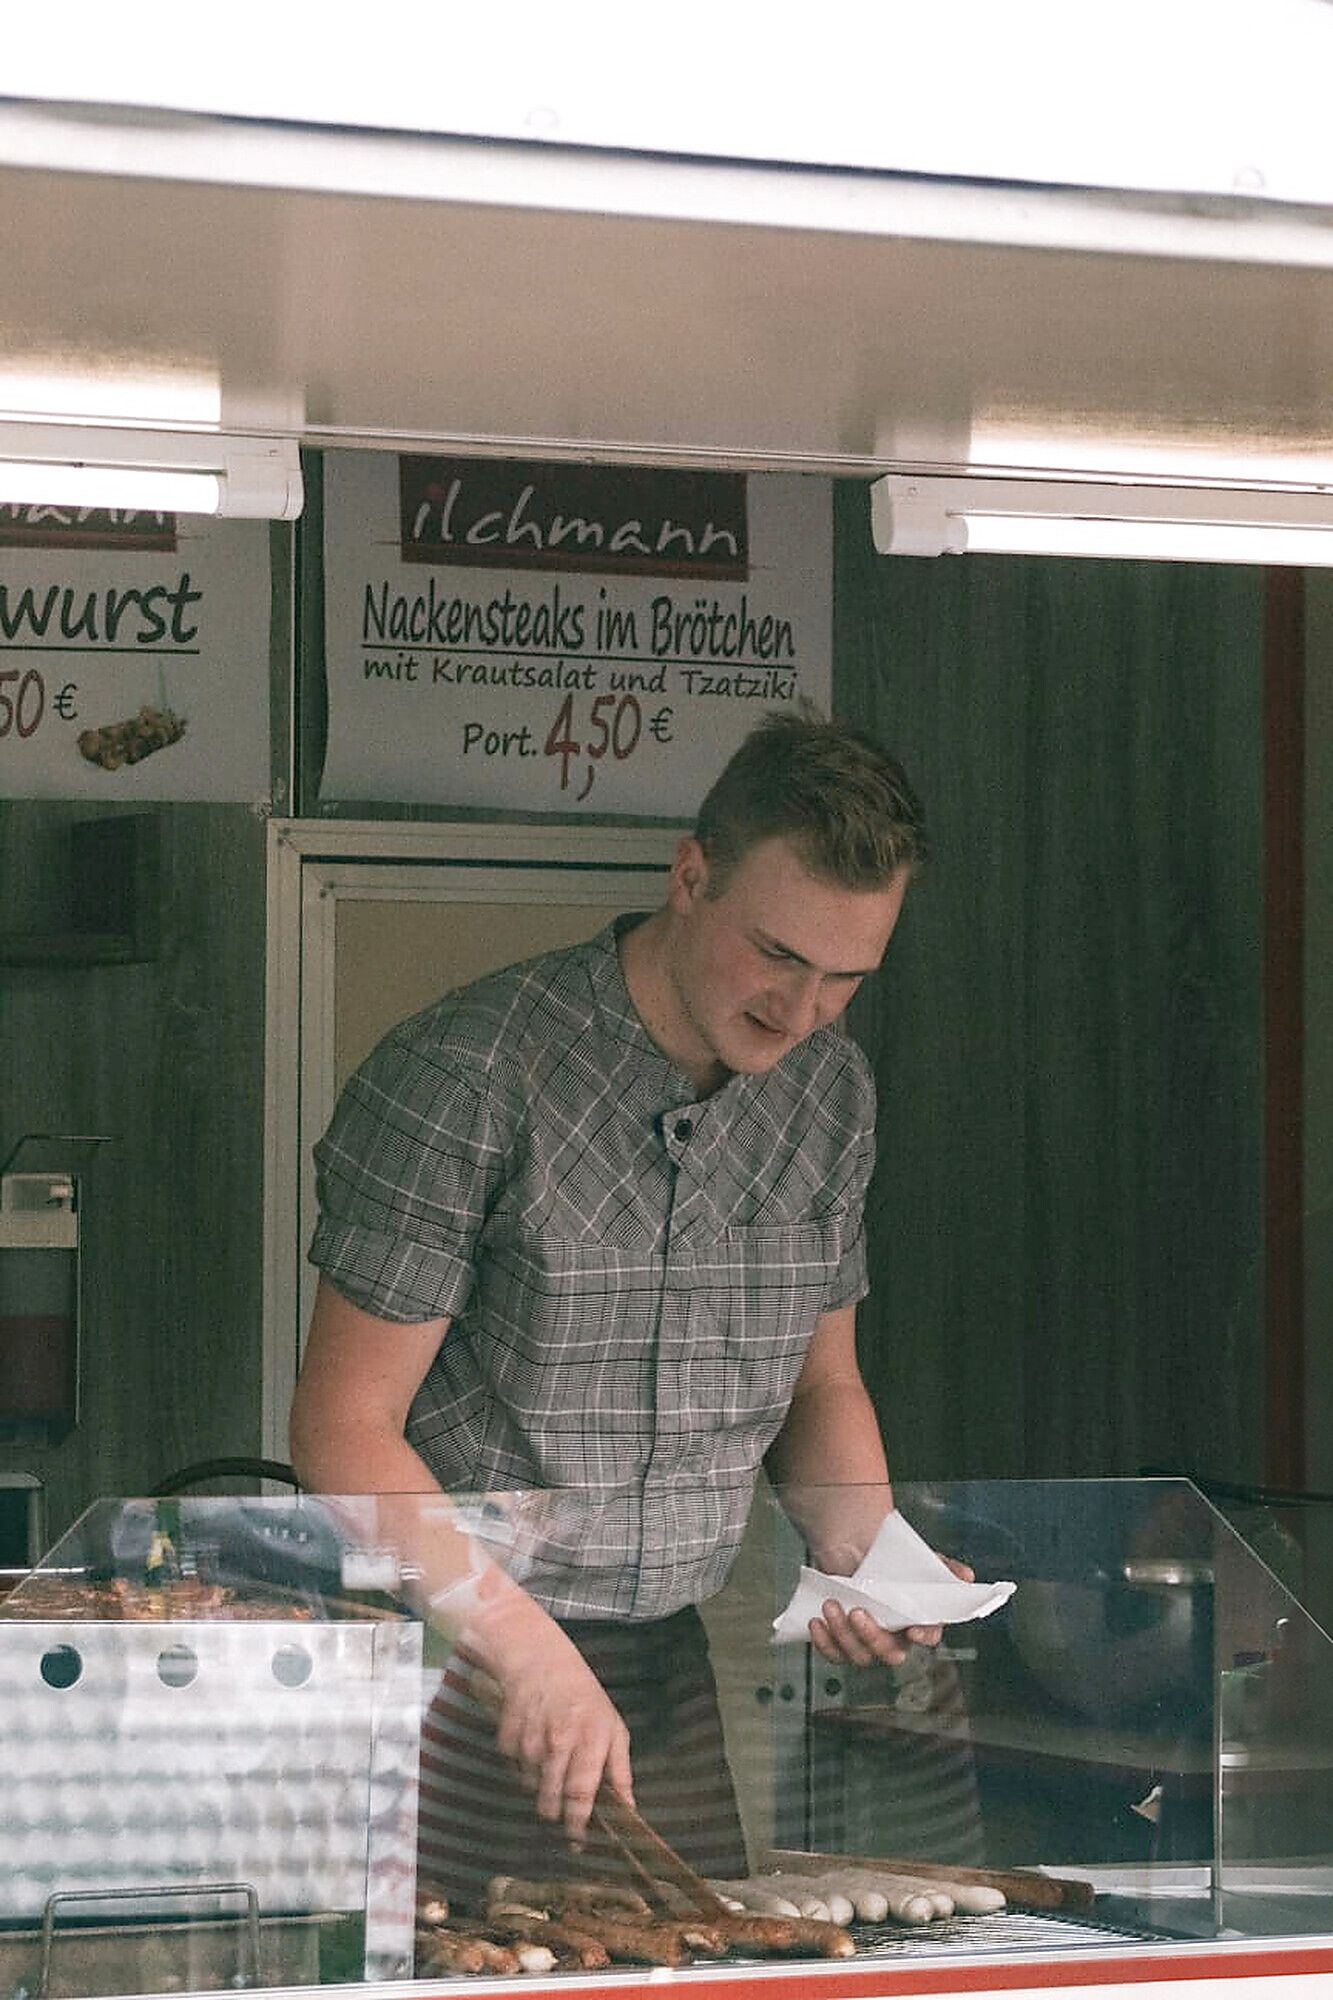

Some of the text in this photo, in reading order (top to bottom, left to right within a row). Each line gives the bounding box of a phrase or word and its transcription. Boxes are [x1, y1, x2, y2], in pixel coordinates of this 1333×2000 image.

[413, 479, 737, 556] ilchmann
[0, 573, 203, 643] wurst
[363, 577, 796, 659] Nackensteaks im Brötchen
[52, 683, 78, 721] €
[364, 652, 797, 699] mit Krautsalat und Tzatziki
[463, 692, 674, 801] Port. 4,50 €
